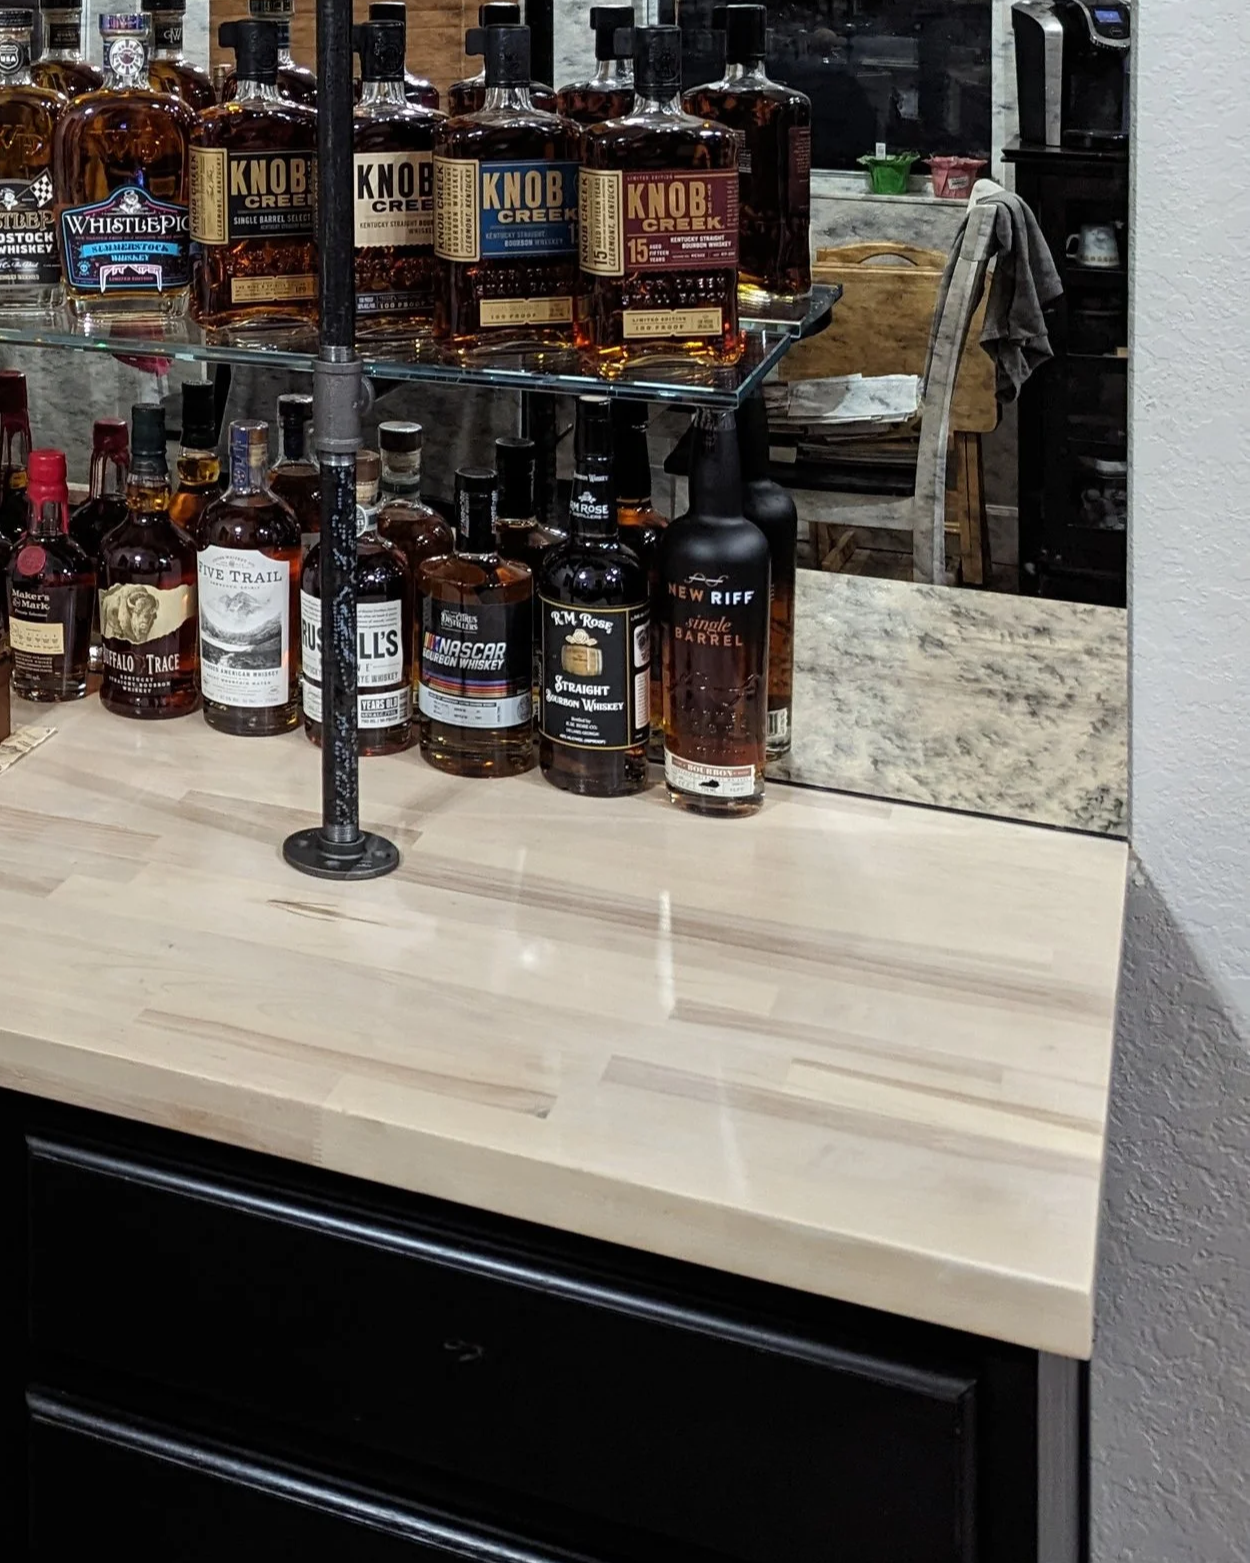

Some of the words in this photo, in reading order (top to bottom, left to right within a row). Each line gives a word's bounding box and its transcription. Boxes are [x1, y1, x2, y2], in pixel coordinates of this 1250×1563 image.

[230, 158, 306, 196] KNOB
[482, 170, 563, 210] KNOB
[627, 181, 707, 219] KNOB
[233, 215, 258, 225] SINGLE
[259, 214, 285, 224] BARREL
[287, 213, 311, 223] SELECT
[390, 220, 417, 228] STRAIGHT
[642, 217, 723, 232] CREEK
[437, 212, 445, 251] KNOB
[670, 236, 698, 244] KENTUCKY
[505, 239, 533, 247] BOURBON
[628, 238, 648, 263] 15
[111, 254, 150, 262] WHISKEY
[594, 251, 607, 266] 15
[580, 503, 608, 515] ROSE
[199, 560, 224, 582] FIVE
[229, 570, 282, 584] TRAIL
[11, 589, 50, 602] Maker's
[668, 581, 703, 603] NEW
[711, 591, 754, 605] RIFF
[21, 599, 50, 610] Mark
[579, 612, 613, 634] ROSE
[686, 614, 731, 636] single
[675, 626, 743, 646] BARREL
[438, 637, 506, 659] NASCAR
[146, 653, 180, 675] TRACE
[423, 647, 458, 667] BOURBON
[459, 657, 504, 670] WHISKEY
[220, 668, 250, 678] AMERICAN
[371, 672, 399, 683] WHISKEY
[555, 675, 610, 696] STRAIGHT
[361, 699, 385, 711] YEARS
[385, 697, 398, 709] OLD
[546, 688, 580, 709] BOURBON
[581, 697, 624, 712] WHISKEY
[687, 764, 732, 777] BOURBON
